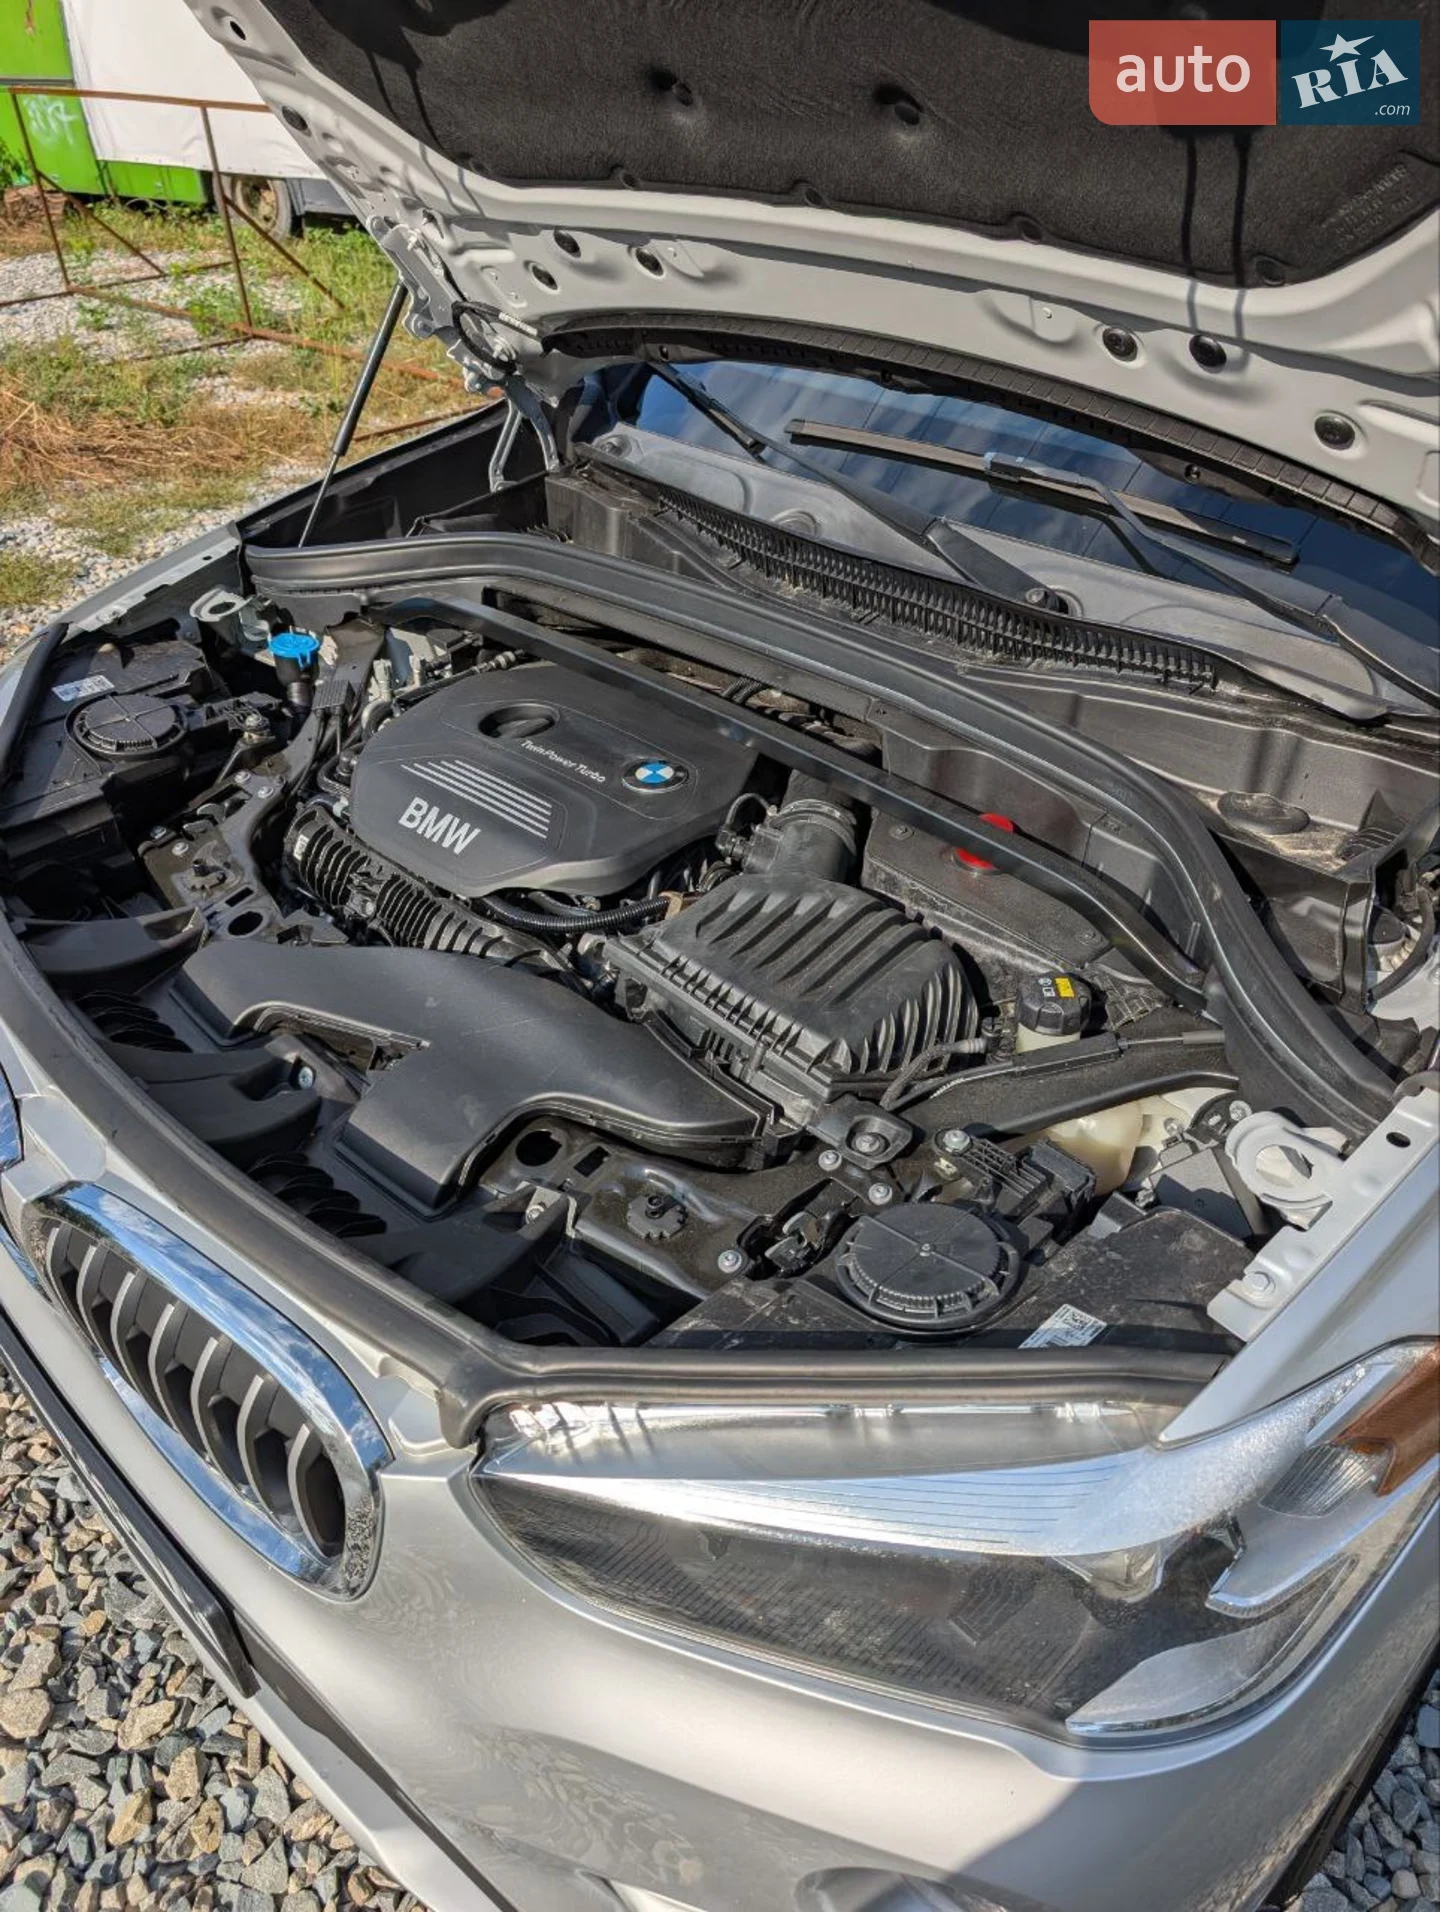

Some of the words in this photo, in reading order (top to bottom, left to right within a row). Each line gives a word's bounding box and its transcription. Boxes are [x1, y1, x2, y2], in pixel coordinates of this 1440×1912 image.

[521, 740, 577, 767] TwinPower
[574, 763, 606, 783] Turbo
[398, 796, 482, 855] BMW
